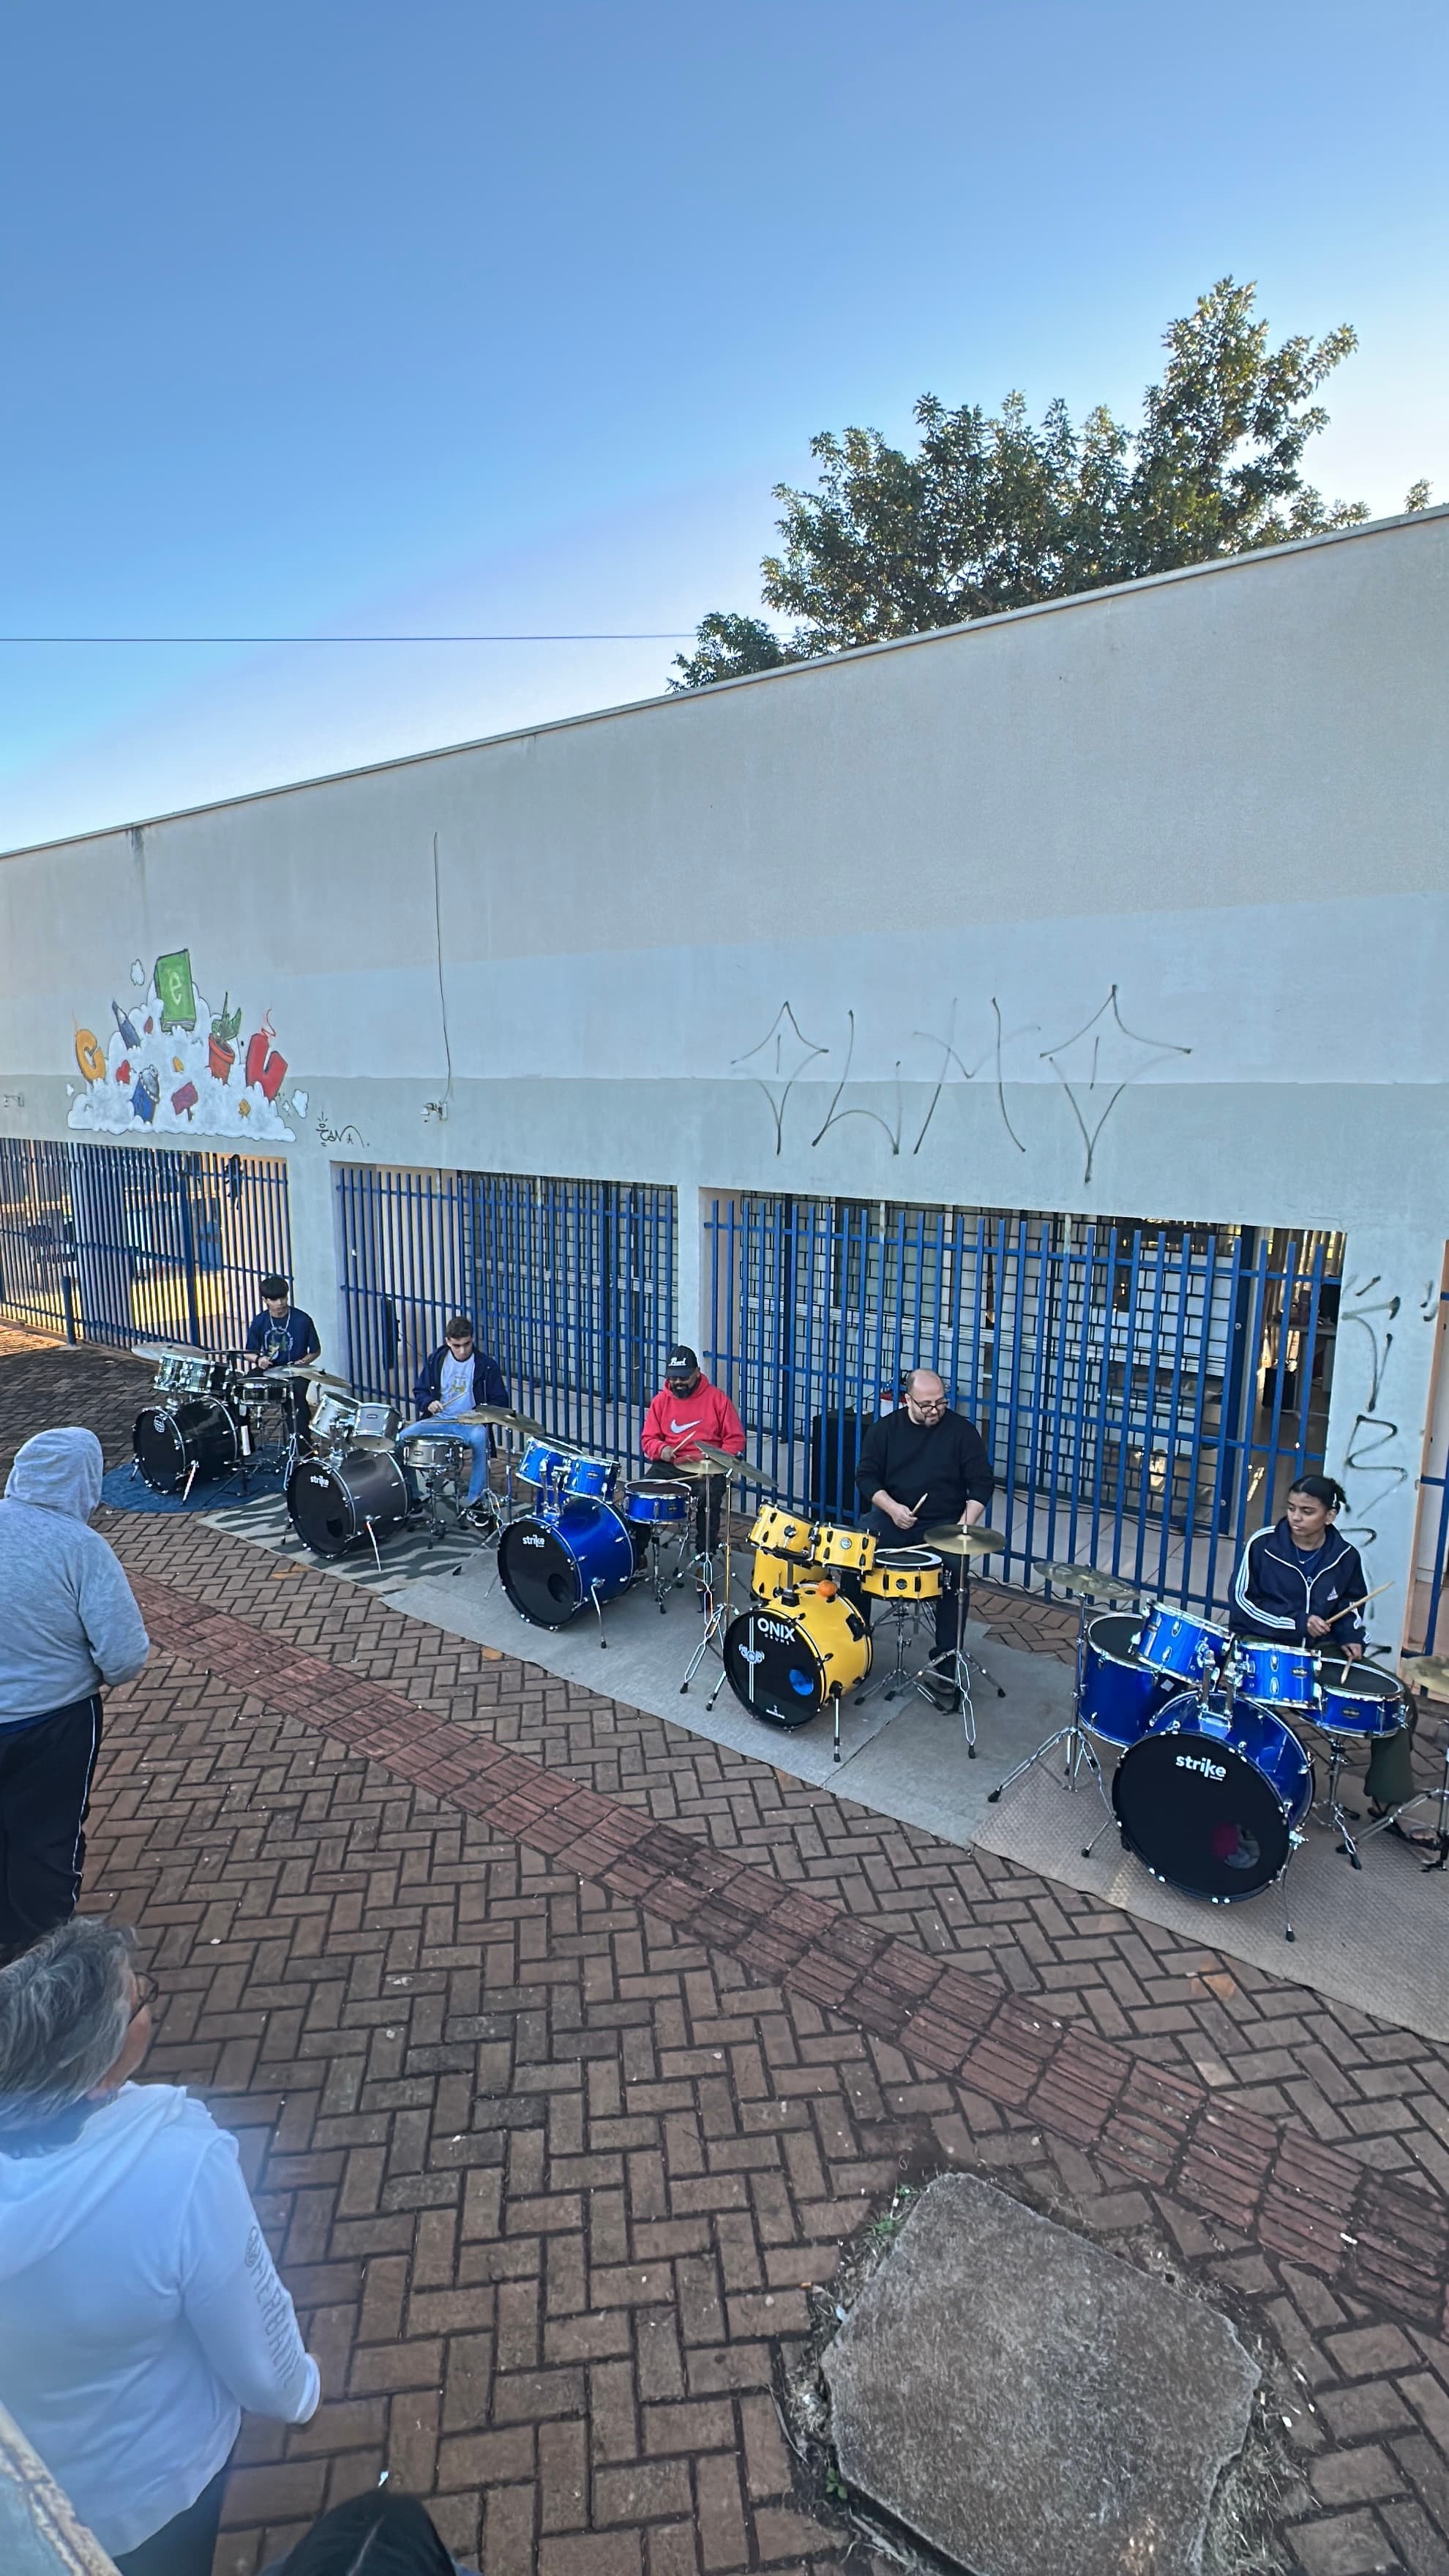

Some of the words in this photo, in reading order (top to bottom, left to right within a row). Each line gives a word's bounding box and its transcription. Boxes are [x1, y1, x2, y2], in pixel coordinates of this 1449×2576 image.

[522, 1534, 545, 1548] strike
[757, 1617, 795, 1642] ONIX
[1175, 1756, 1227, 1778] strike
